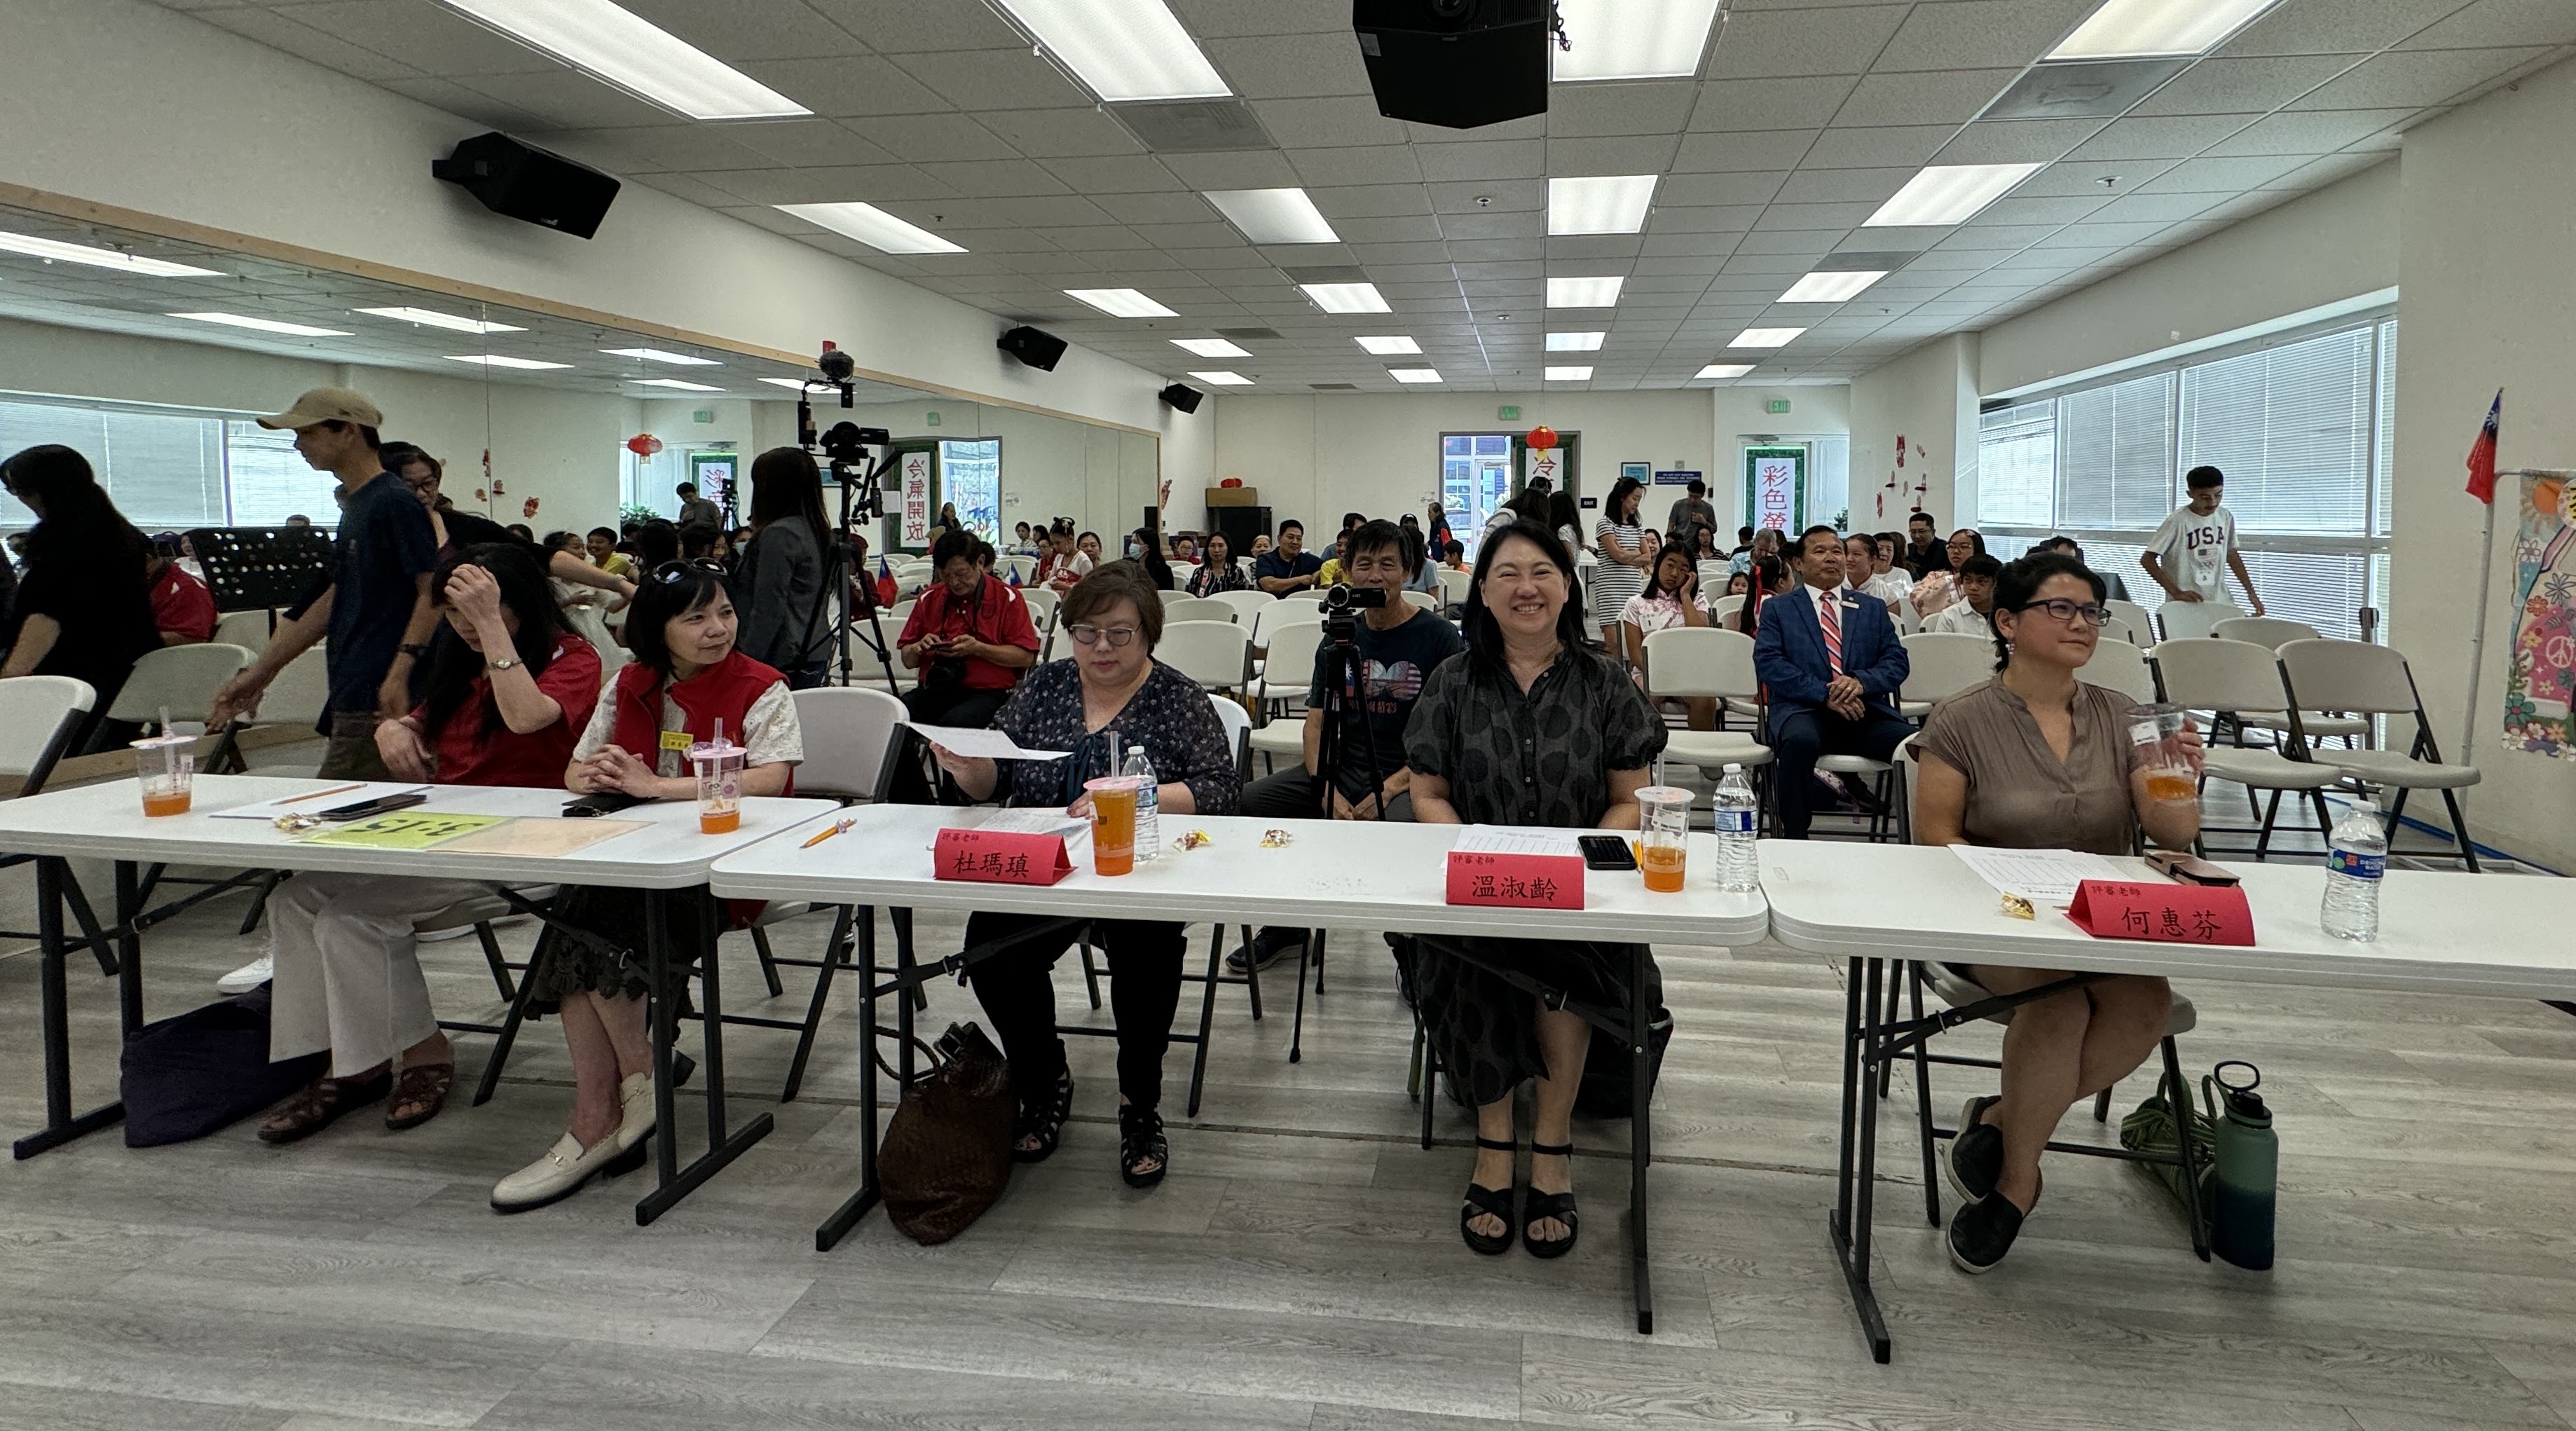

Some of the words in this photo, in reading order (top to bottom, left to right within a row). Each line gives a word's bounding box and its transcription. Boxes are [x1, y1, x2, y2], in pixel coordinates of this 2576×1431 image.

[1533, 456, 1556, 481] 冷
[2186, 526, 2224, 550] USA
[345, 819, 484, 837] 3:15
[1453, 856, 1495, 865] 評審老師
[2091, 885, 2141, 898] 評審老師
[2121, 907, 2222, 940] 何惠芬
